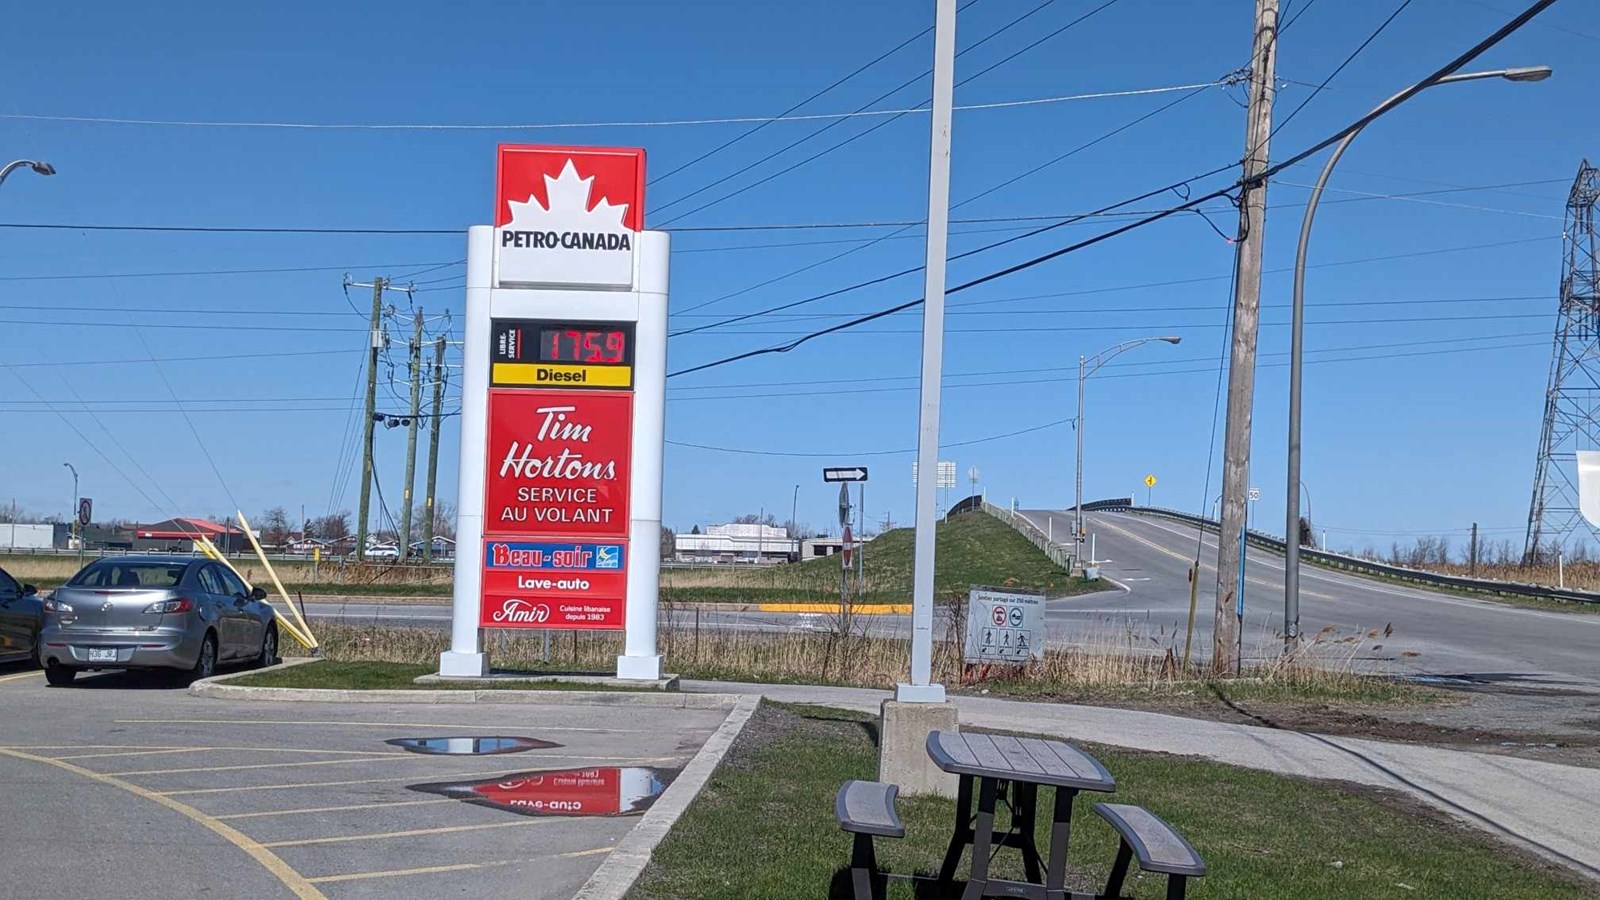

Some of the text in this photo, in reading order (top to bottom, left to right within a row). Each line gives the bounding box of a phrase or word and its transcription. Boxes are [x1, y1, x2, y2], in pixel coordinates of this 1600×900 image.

[508, 329, 516, 358] SERVICE
[536, 368, 587, 382] Diesel
[536, 406, 592, 442] Tim
[500, 441, 616, 480] Hortons
[517, 487, 597, 503] SERVICE
[1249, 491, 1259, 500] 50
[501, 507, 613, 523] AU VOLANT
[492, 543, 592, 568] Beau-soir
[518, 575, 590, 590] Lave-auto
[493, 599, 550, 623] Amir
[565, 613, 586, 621] depuis
[584, 605, 611, 613] libanaise
